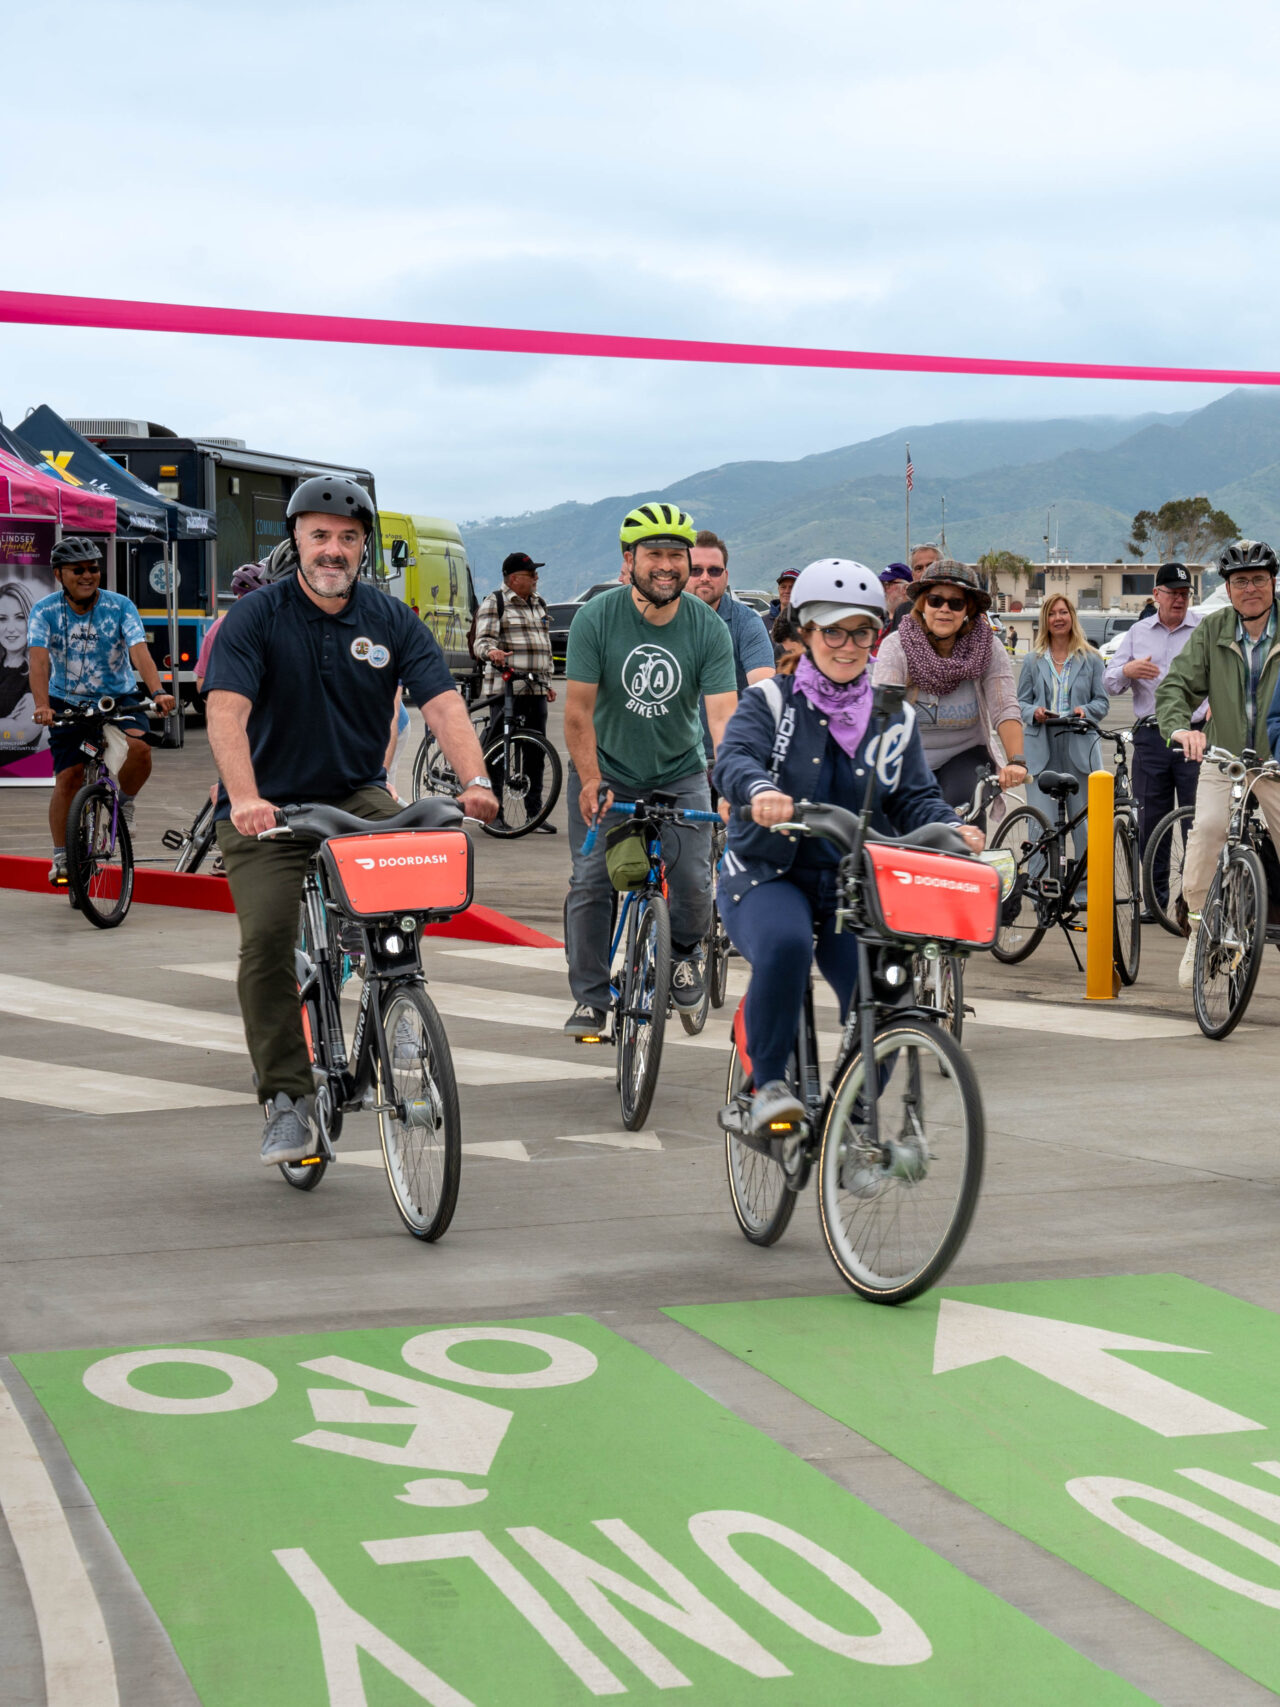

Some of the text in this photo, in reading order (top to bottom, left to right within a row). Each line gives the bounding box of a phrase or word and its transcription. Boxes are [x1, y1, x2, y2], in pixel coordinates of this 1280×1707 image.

[255, 519, 289, 537] COMMUNIT
[1, 535, 35, 543] LINDSEY
[939, 703, 977, 714] SANT
[379, 854, 448, 868] DOORDASH
[914, 875, 981, 894] DOORDASH
[352, 981, 371, 1060] Metro Bik
[272, 1509, 933, 1707] ONLY
